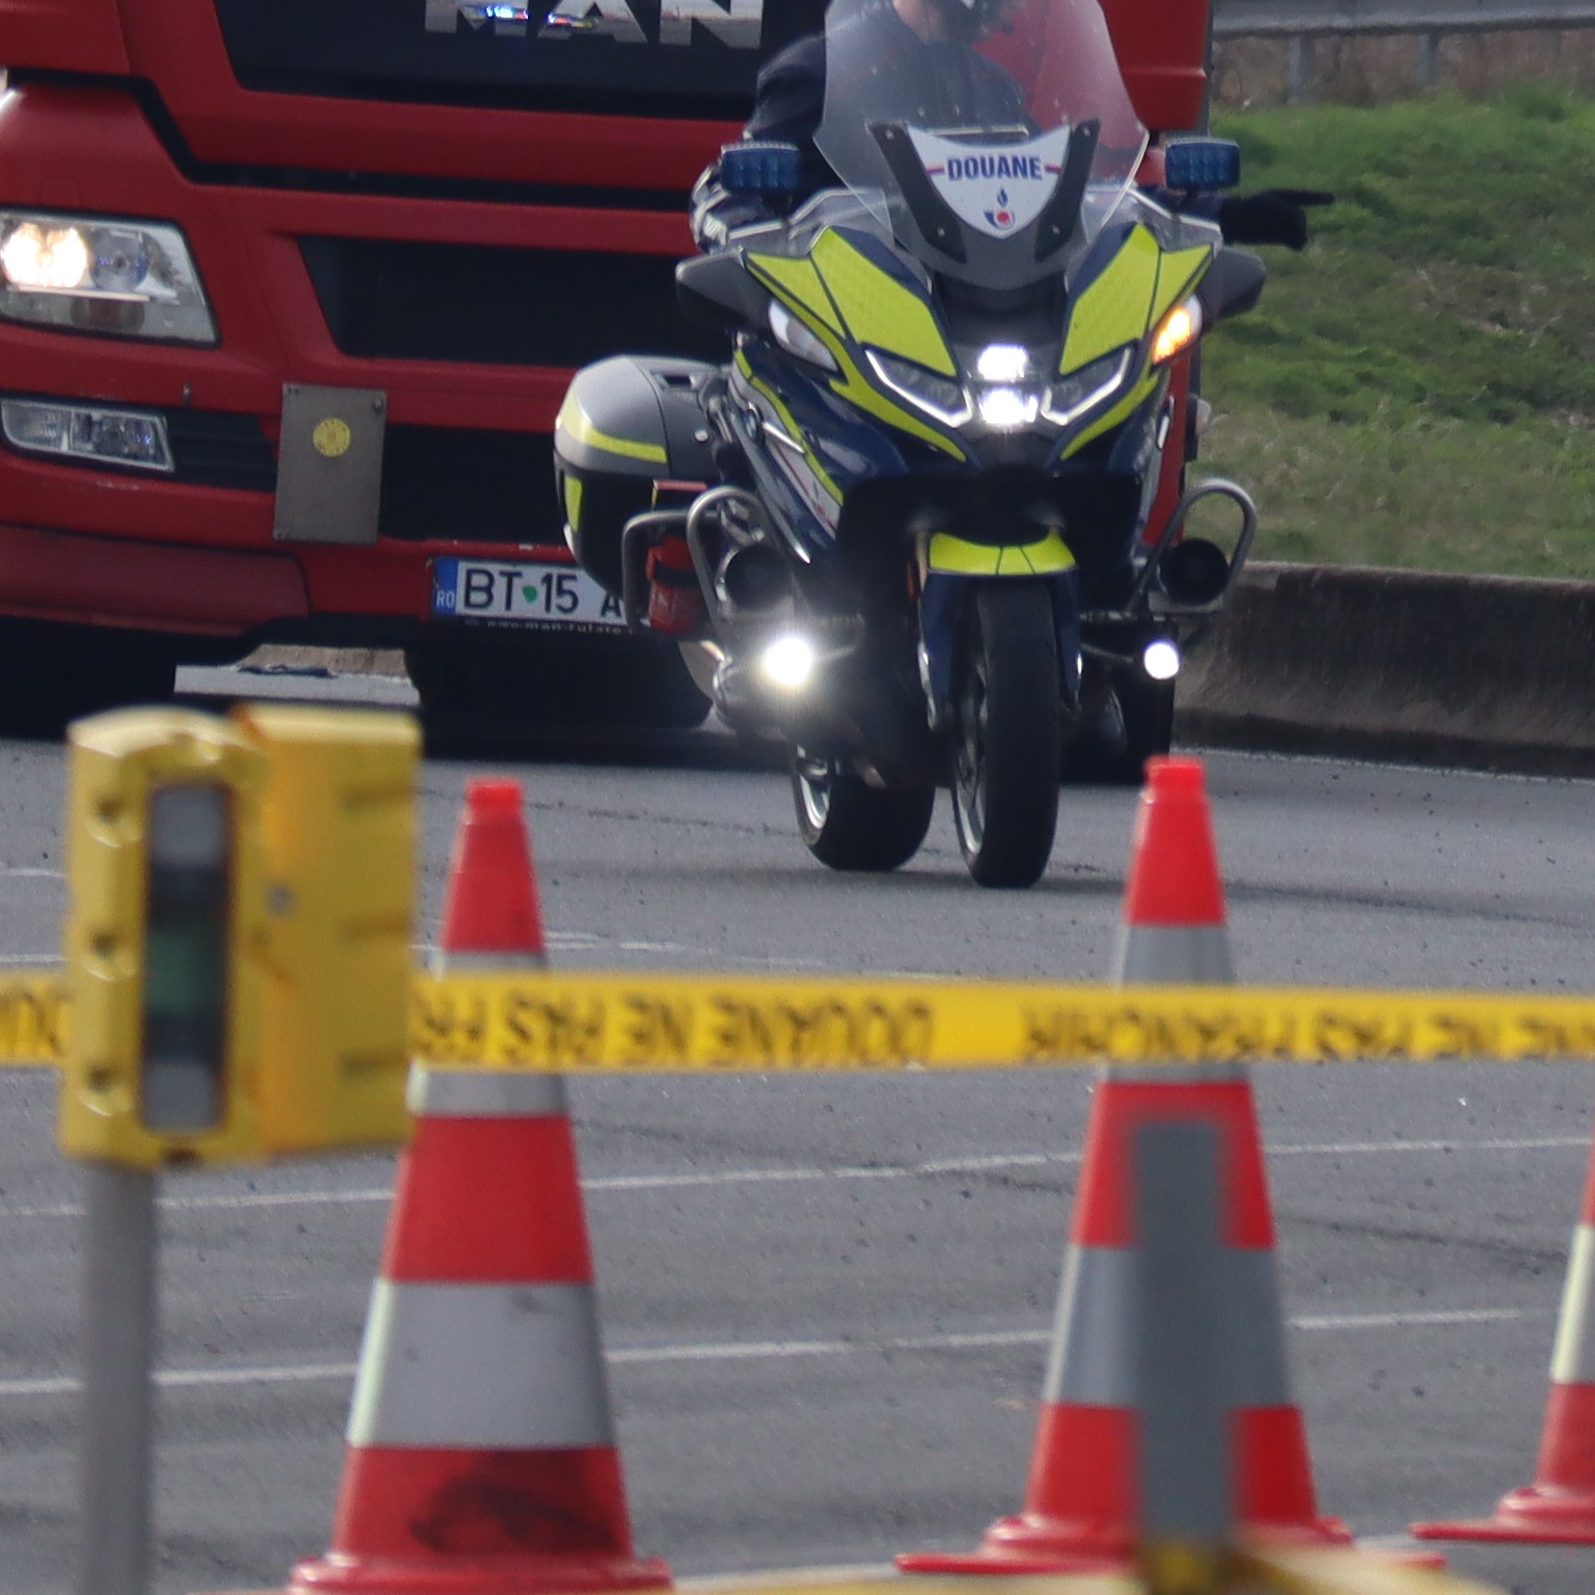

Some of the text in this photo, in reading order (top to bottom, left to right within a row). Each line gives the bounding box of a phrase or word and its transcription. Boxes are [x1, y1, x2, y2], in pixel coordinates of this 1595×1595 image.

[947, 155, 1043, 181] DOUANE
[436, 590, 455, 609] RO
[464, 568, 523, 611] BT
[540, 573, 580, 614] 15
